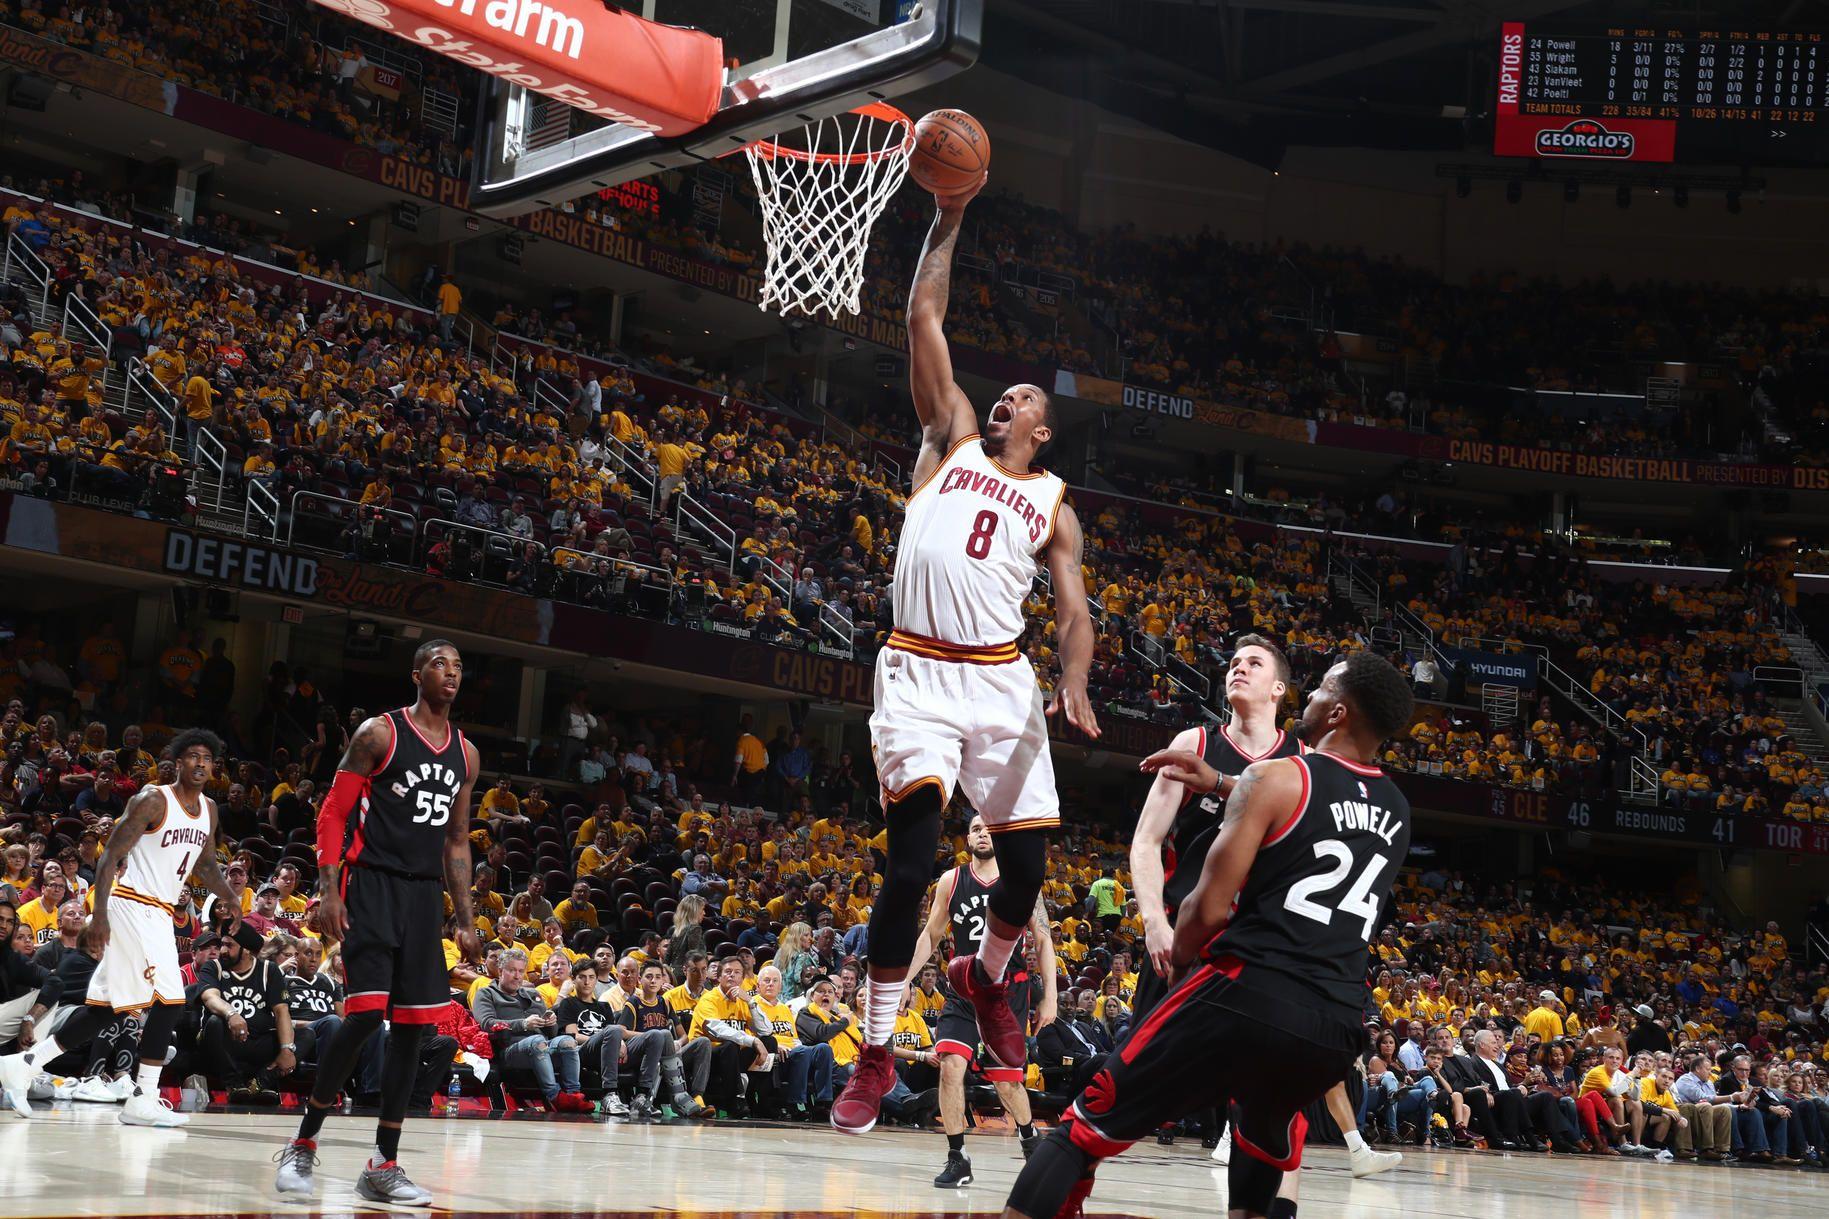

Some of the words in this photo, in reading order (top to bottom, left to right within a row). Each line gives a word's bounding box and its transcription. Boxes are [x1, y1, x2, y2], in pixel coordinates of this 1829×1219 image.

[397, 27, 542, 88] State
[1530, 39, 1541, 49] 24
[1547, 40, 1576, 50] Powell
[1609, 41, 1621, 51] 18
[1633, 42, 1653, 53] 3/11
[1664, 43, 1685, 54] 27%
[1700, 43, 1715, 54] 2/7
[1731, 45, 1745, 55] 1/2
[1778, 46, 1784, 56] 0
[1809, 47, 1817, 57] 4
[1546, 53, 1575, 64] Wright
[1635, 55, 1650, 65] 0/0
[1665, 56, 1680, 67] 0%
[1700, 57, 1715, 67] 0/0
[1729, 58, 1744, 68] 2/2
[1758, 58, 1764, 69] 0
[1777, 59, 1783, 69] 0
[1794, 59, 1800, 69] 0
[1809, 59, 1815, 70] 0
[378, 71, 397, 87] 207
[1499, 34, 1522, 104] RAPTORS
[1528, 64, 1540, 74] 43
[1610, 66, 1616, 76] 0
[1634, 67, 1650, 77] 0/0
[1664, 68, 1680, 78] 0%
[1699, 69, 1714, 80] 0/0
[1728, 70, 1743, 80] 0/0
[1757, 70, 1763, 80] 2
[1776, 71, 1782, 81] 0
[1793, 71, 1799, 81] 0
[1808, 72, 1814, 82] 0
[1527, 76, 1539, 86] 23
[1544, 77, 1582, 87] VanVleet
[1609, 78, 1615, 88] 0
[1633, 79, 1648, 90] 0/0
[1663, 80, 1679, 90] 0%
[1697, 81, 1713, 91] 0/0
[1727, 82, 1742, 92] 0/0
[1756, 82, 1762, 92] 0
[1775, 83, 1781, 93] 0
[1791, 83, 1797, 93] 0
[1807, 84, 1813, 94] 0
[1527, 88, 1538, 98] 42
[1608, 90, 1614, 100] 0
[1632, 91, 1646, 101] 0/1
[1663, 92, 1678, 103] 0%
[1696, 93, 1712, 104] 0/0
[1726, 94, 1741, 104] 0/0
[1755, 94, 1761, 105] 0
[1774, 95, 1780, 106] 0
[1791, 96, 1797, 106] 0
[1806, 96, 1812, 106] 0
[1526, 103, 1548, 114] TEAM
[1551, 104, 1583, 115] TOTALS
[1659, 107, 1680, 118] 41%
[1751, 110, 1762, 121] 41
[1770, 110, 1783, 121] 22
[1788, 111, 1799, 121] 12
[1802, 111, 1816, 122] 22
[1539, 133, 1631, 149] GEORGIO'S
[381, 155, 435, 199] CAVS
[530, 210, 646, 268] BASKETBALL
[650, 249, 716, 287] PRESENTED
[719, 271, 734, 292] BY
[872, 315, 910, 353] MAR
[1122, 386, 1193, 420] DEFEND
[1449, 440, 1494, 466] CAVS
[1498, 445, 1572, 474] PLAYOFF
[1575, 453, 1692, 482] BASKETBALL
[1696, 463, 1769, 485] PRESENTED
[1772, 468, 1789, 486] BY
[939, 467, 1047, 544] CAVALIERS
[966, 510, 999, 560] 8
[165, 531, 318, 597] DEFEND
[713, 620, 751, 639] Huntington
[774, 650, 834, 696] CAVS
[1471, 663, 1527, 679] HYUNDAI
[412, 789, 451, 827] 55
[1329, 800, 1403, 846] POWELL
[1514, 792, 1548, 821] CLE
[1567, 802, 1590, 827] 46
[1615, 810, 1687, 833] REBOUNDS
[1712, 817, 1735, 843] 41
[1764, 823, 1803, 849] TOR
[176, 851, 191, 881] 4
[1283, 839, 1389, 942] 24
[953, 894, 990, 925] RAPT
[222, 986, 267, 1010] APTORS
[231, 999, 256, 1019] 95
[309, 998, 328, 1013] 10
